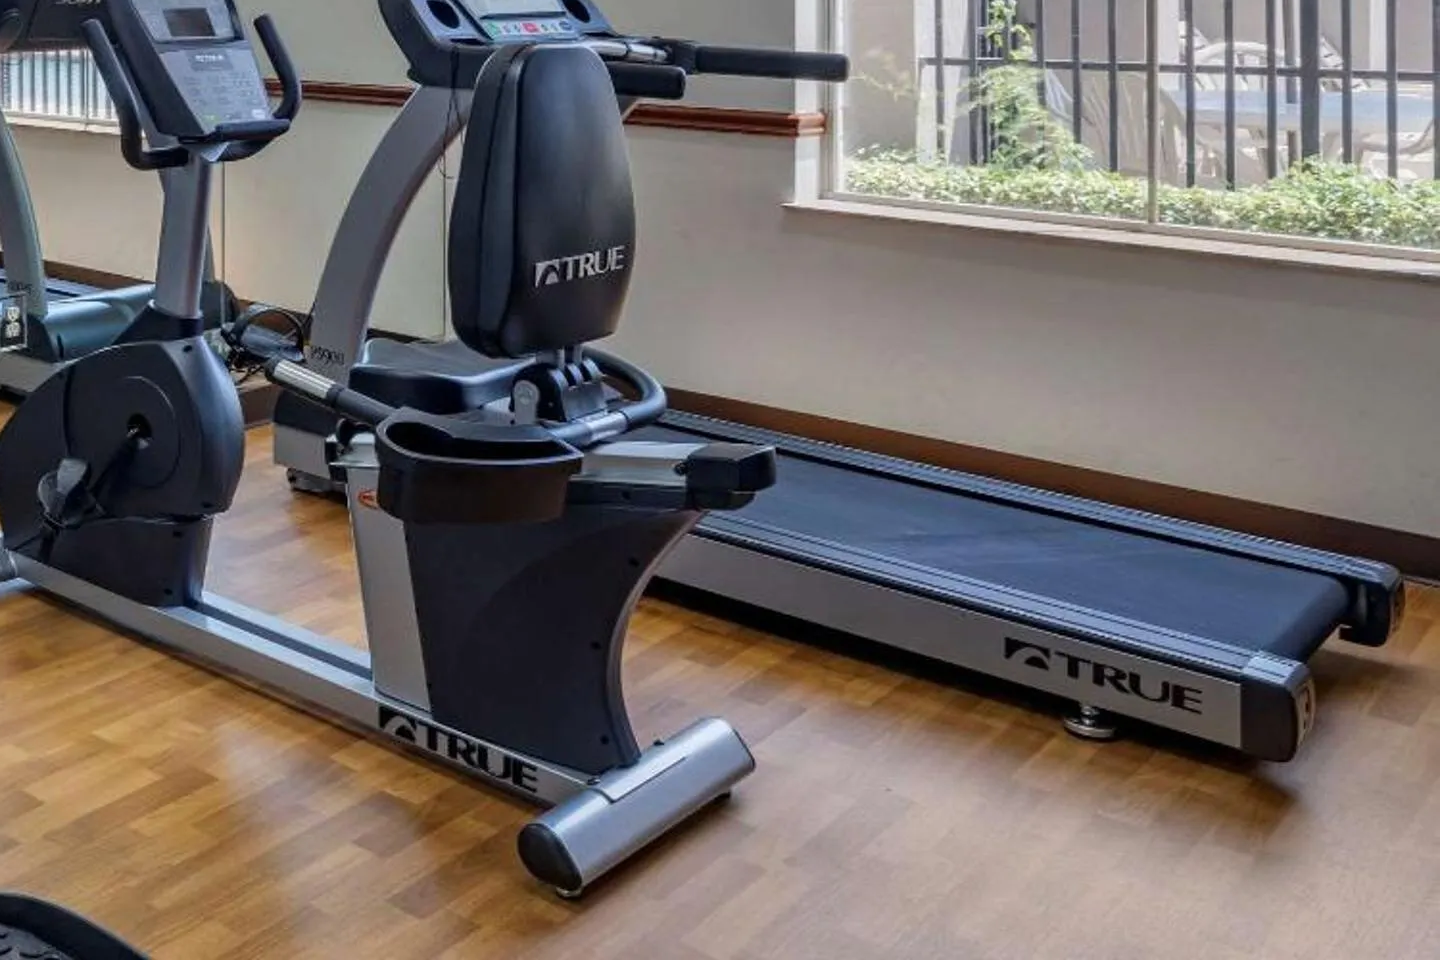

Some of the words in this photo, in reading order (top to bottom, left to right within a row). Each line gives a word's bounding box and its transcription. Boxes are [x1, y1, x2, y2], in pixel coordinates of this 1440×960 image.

[561, 244, 626, 281] TRUE
[1055, 650, 1203, 716] TRUE
[416, 719, 538, 794] TRUE
